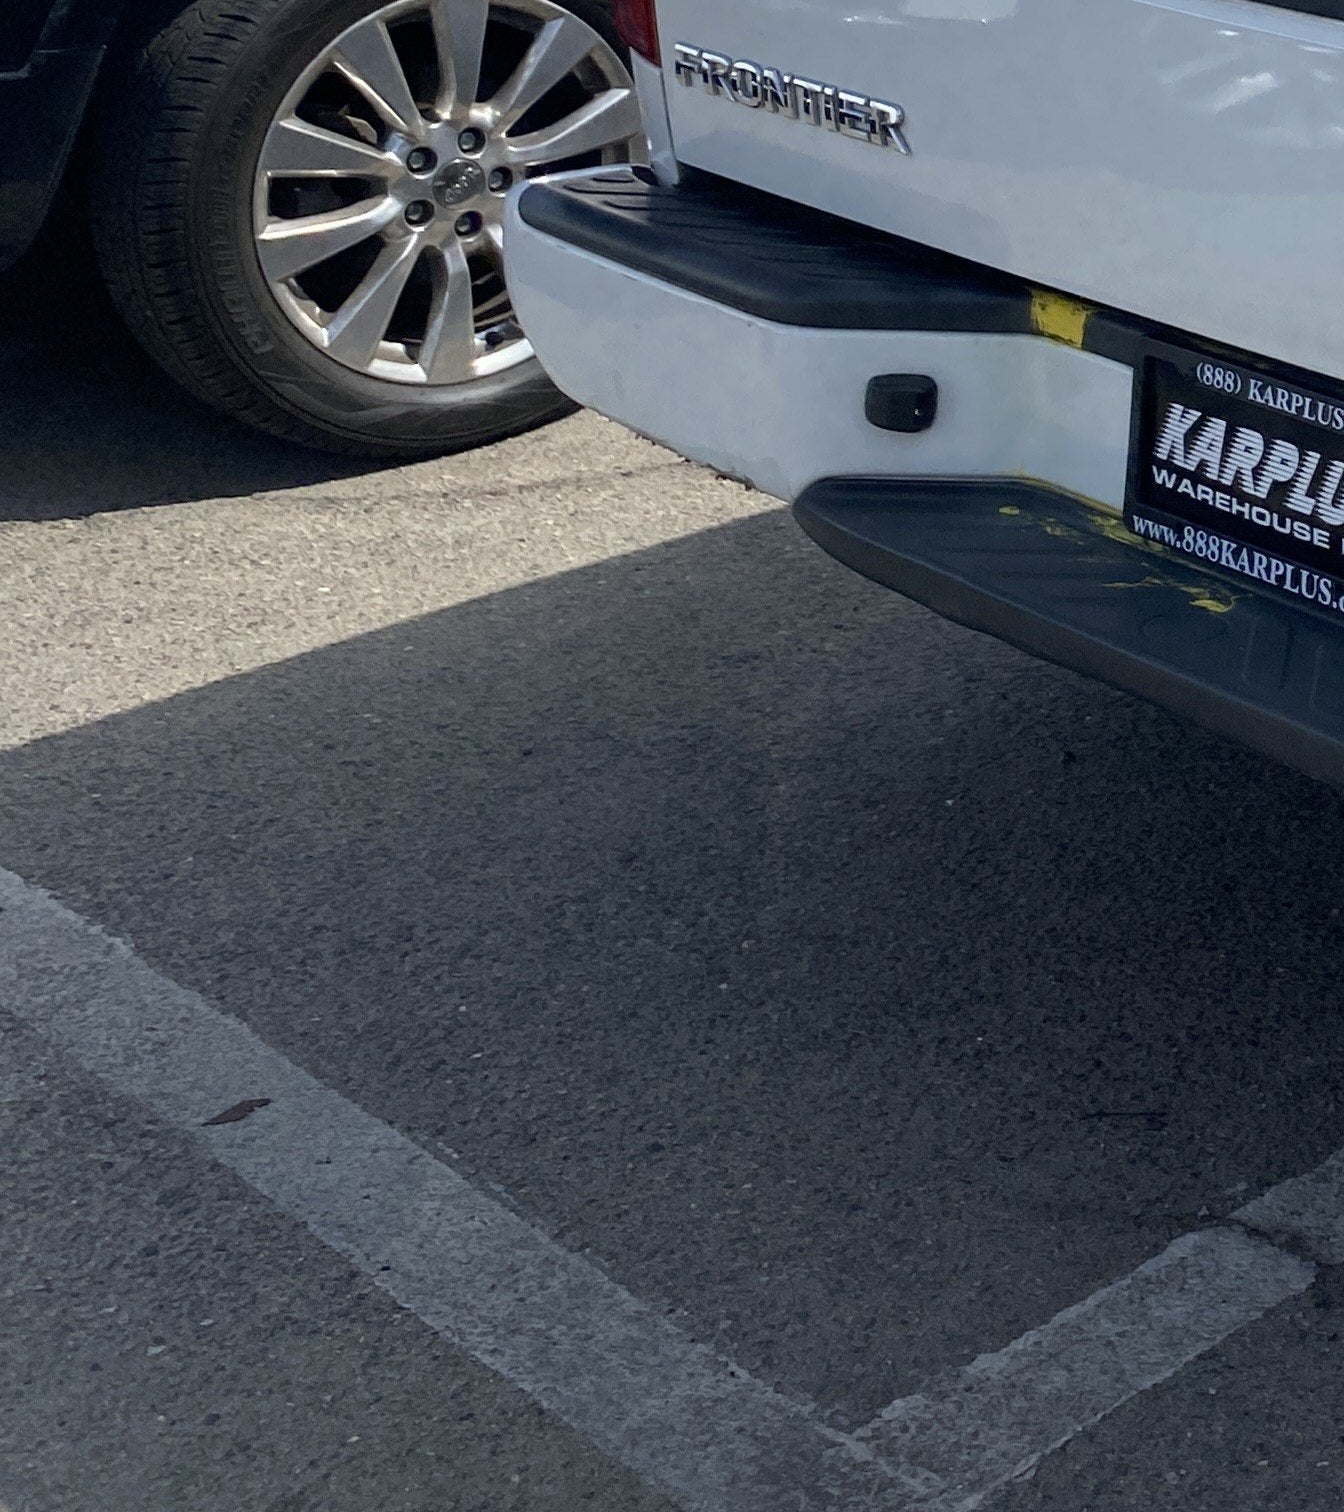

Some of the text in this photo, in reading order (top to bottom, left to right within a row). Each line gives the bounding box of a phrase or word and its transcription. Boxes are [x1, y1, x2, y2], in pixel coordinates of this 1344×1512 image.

[674, 41, 912, 156] FRONTIER
[1196, 361, 1242, 394] (888)
[1151, 465, 1330, 550] WAREHOUSE
